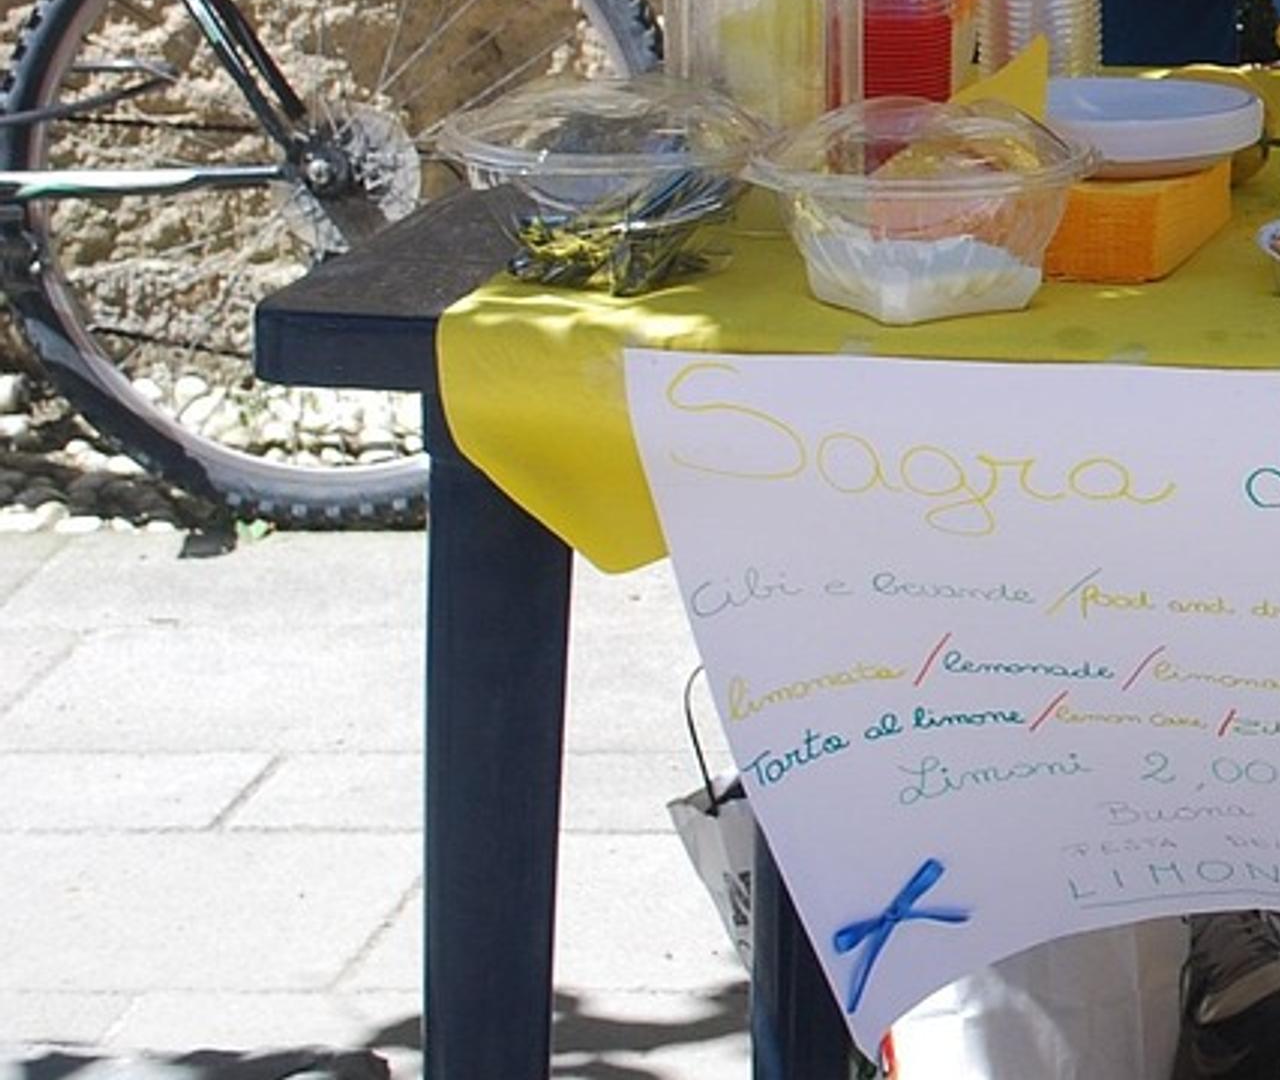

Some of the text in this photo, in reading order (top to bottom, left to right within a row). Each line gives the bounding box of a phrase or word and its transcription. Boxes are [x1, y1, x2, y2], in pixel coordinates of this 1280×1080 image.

[666, 361, 1177, 537] Sagra
[872, 572, 1036, 604] bevande
[1168, 597, 1236, 615] and
[865, 712, 903, 741] al
[899, 754, 1096, 806] Limoni
